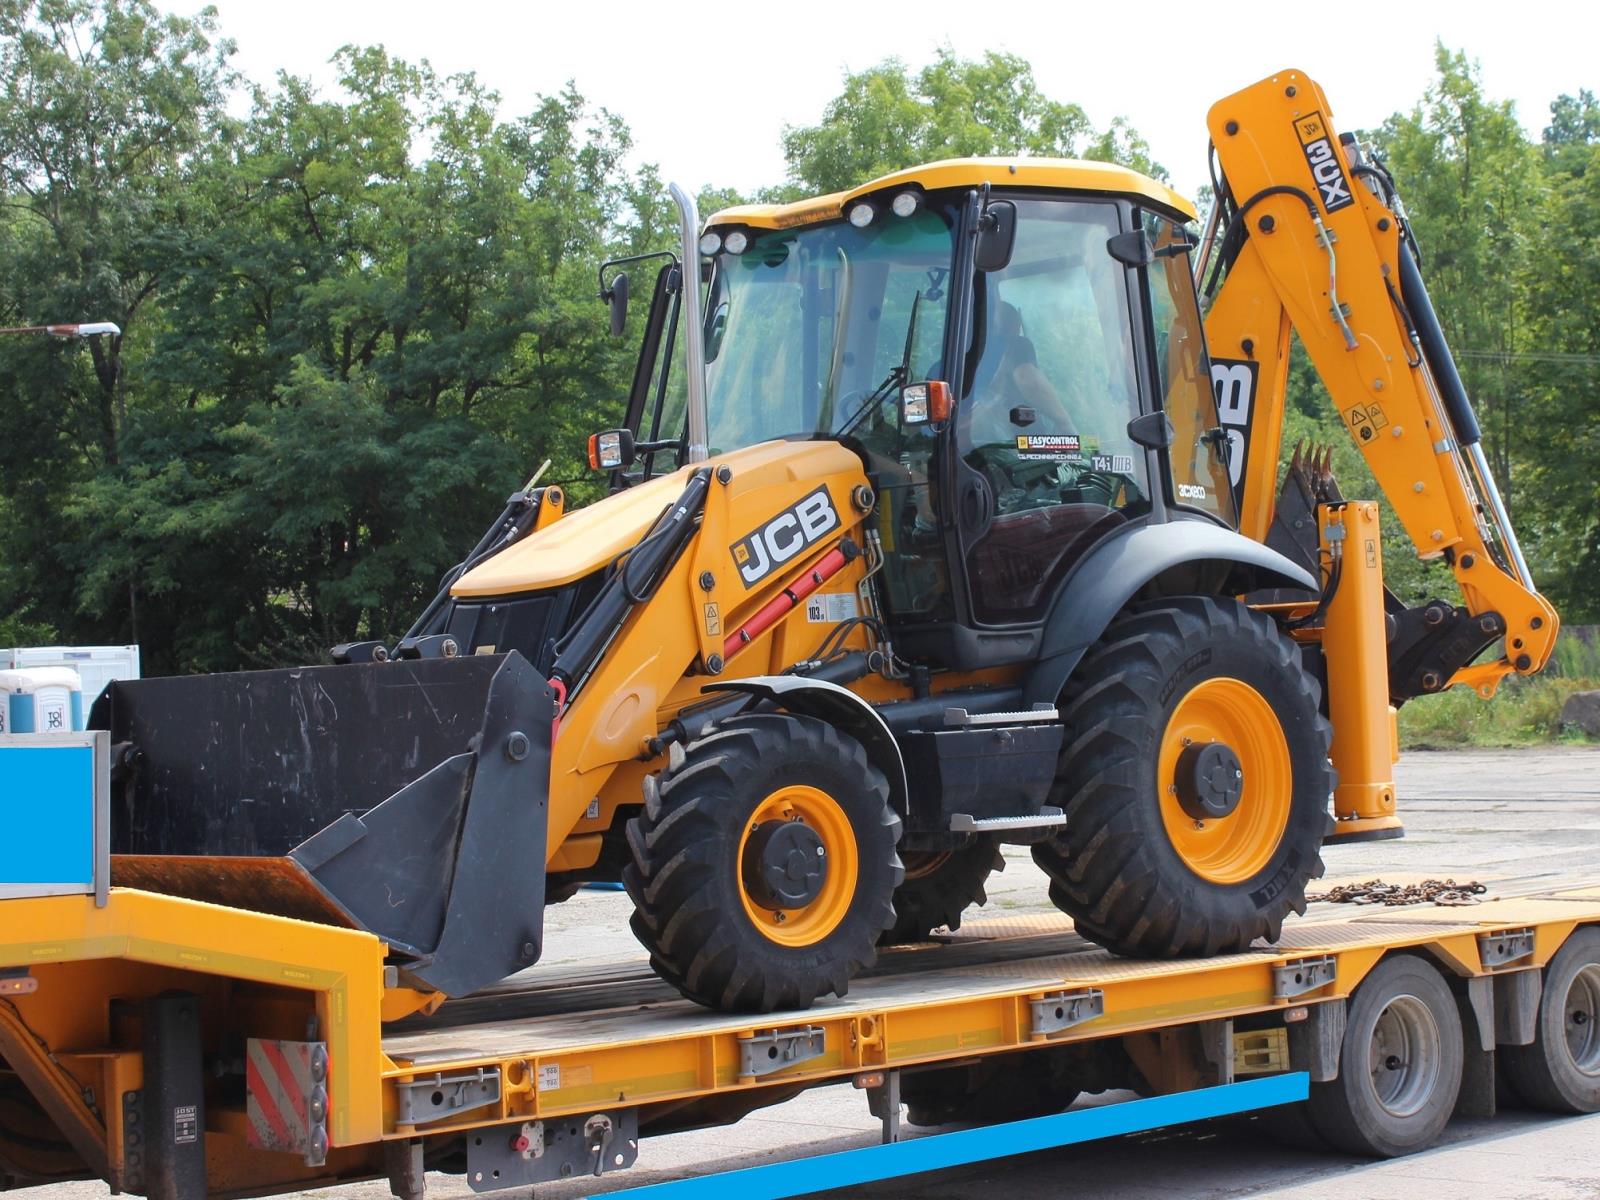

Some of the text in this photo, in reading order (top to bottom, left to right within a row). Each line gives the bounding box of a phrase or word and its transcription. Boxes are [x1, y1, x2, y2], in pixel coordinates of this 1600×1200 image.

[1306, 139, 1351, 205] 3CX
[1091, 455, 1112, 472] T4i
[741, 491, 837, 583] JCB
[808, 606, 820, 621] 103
